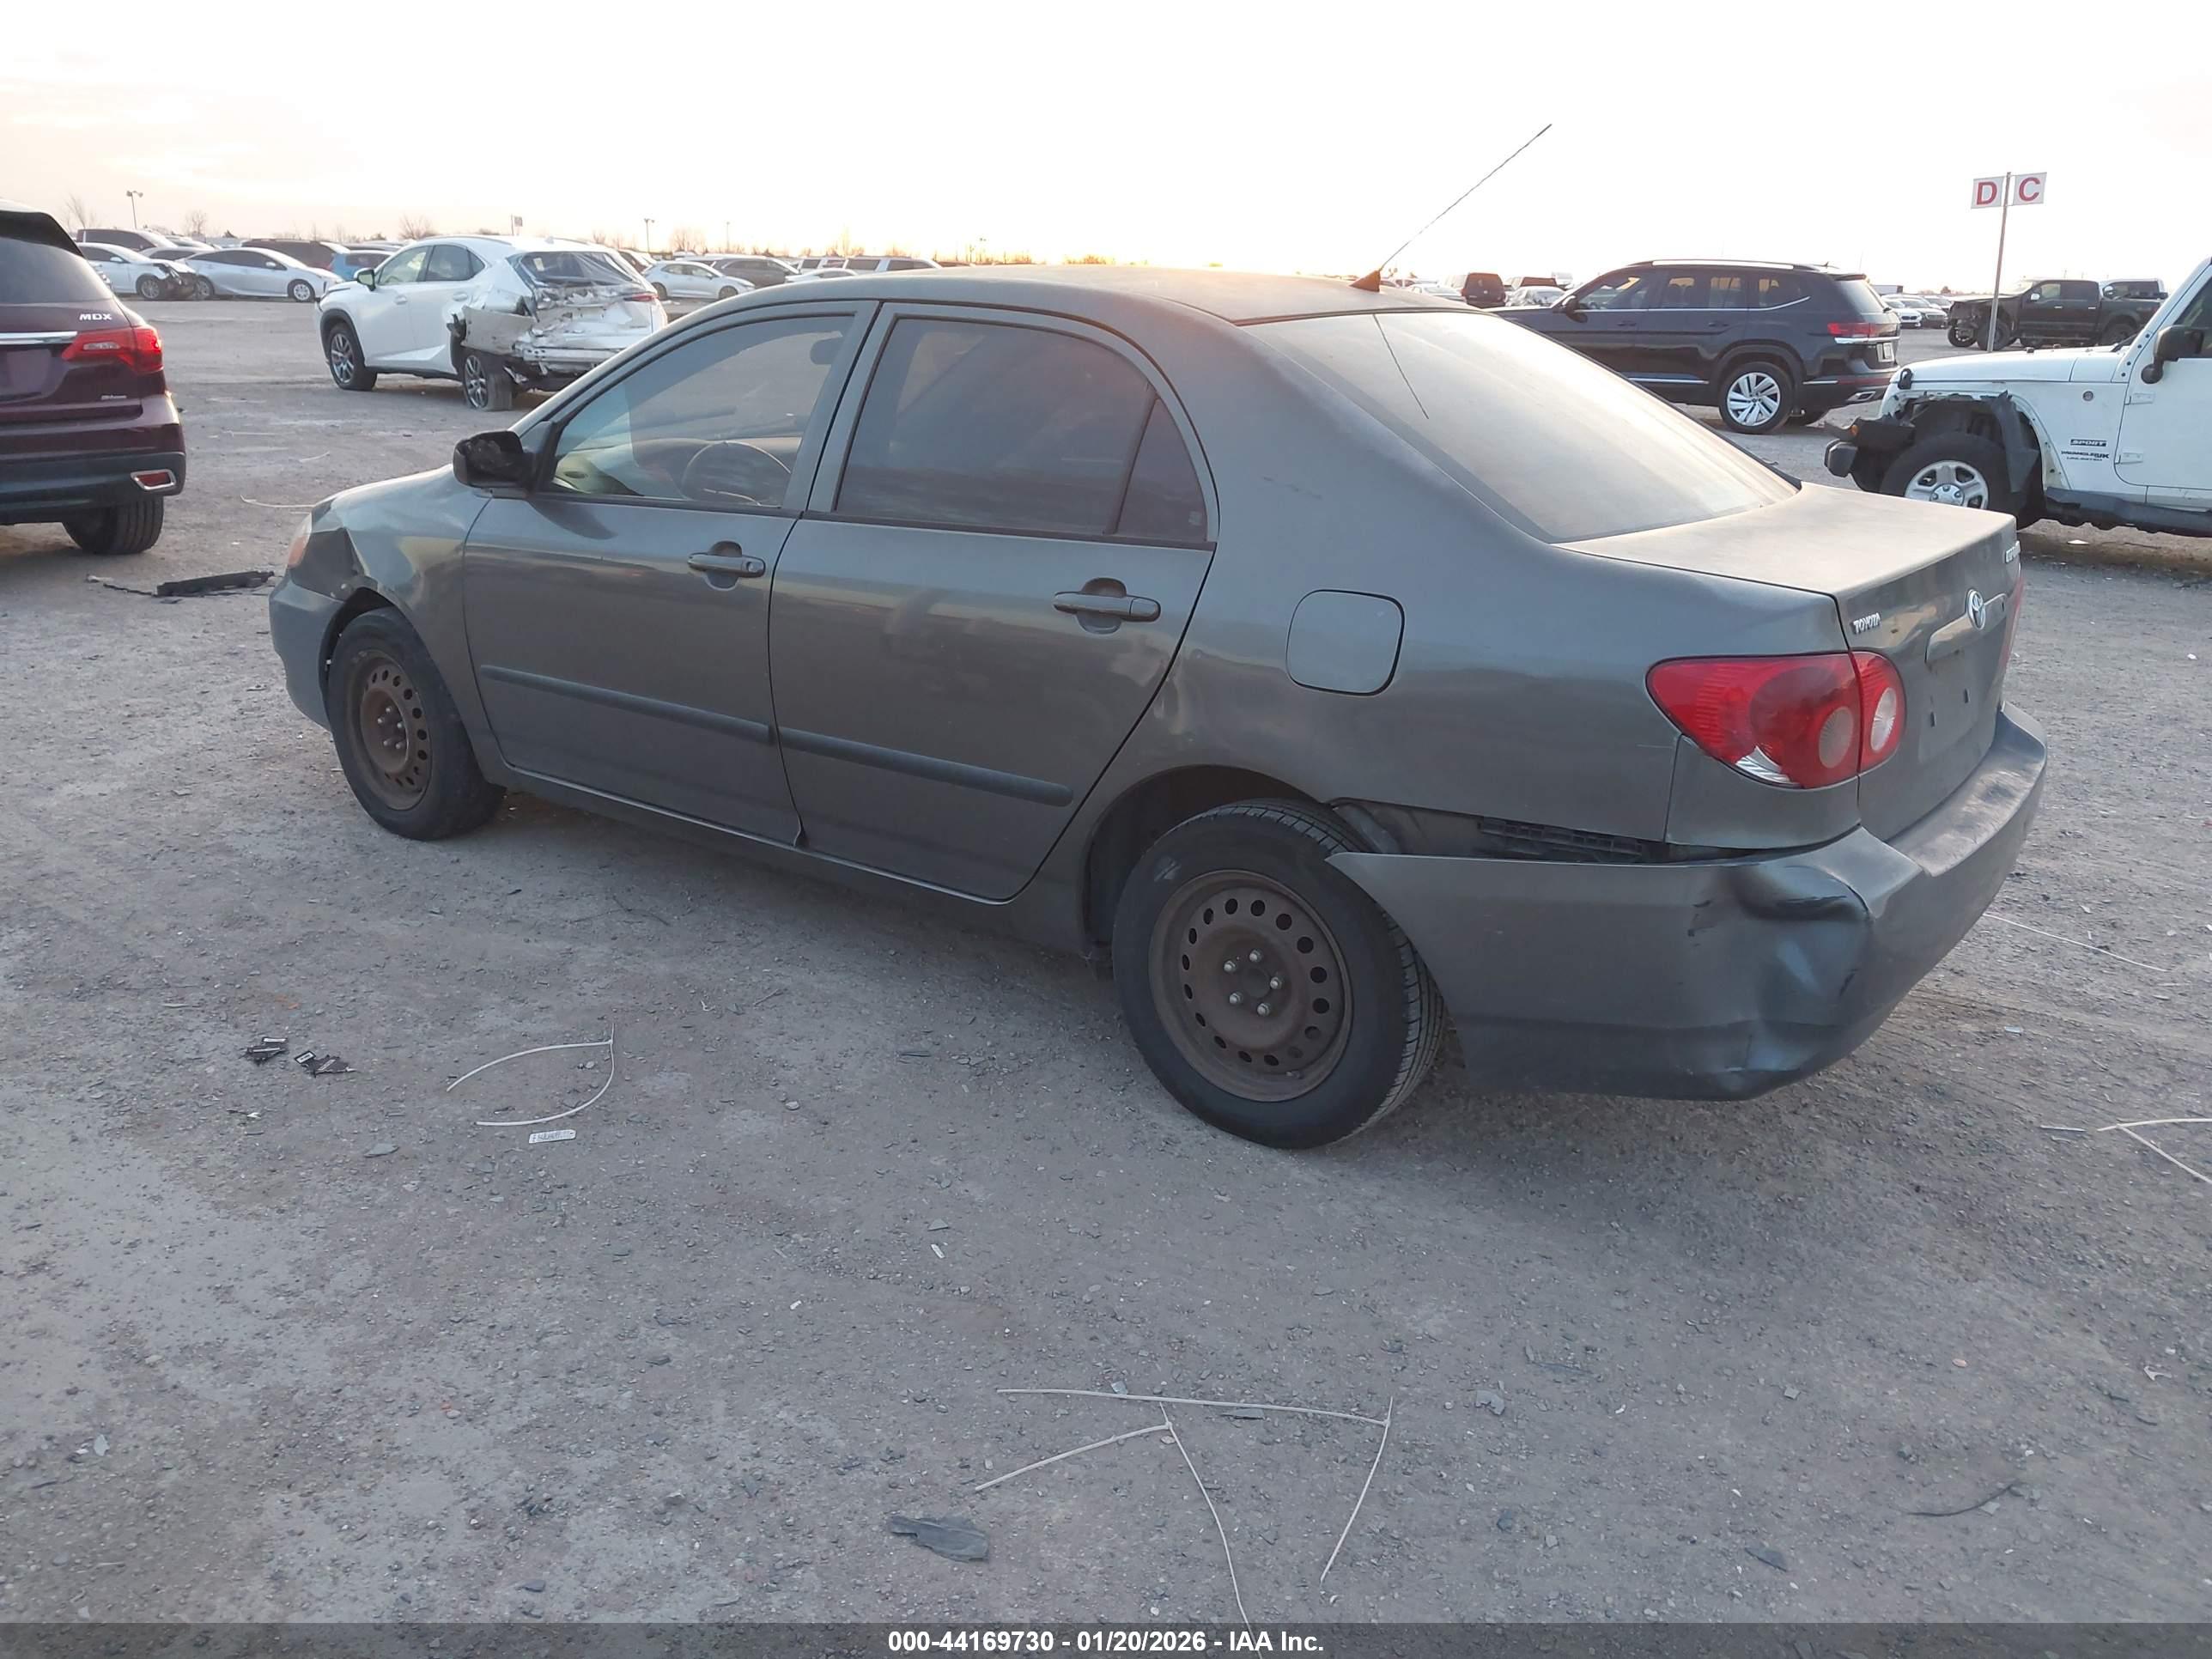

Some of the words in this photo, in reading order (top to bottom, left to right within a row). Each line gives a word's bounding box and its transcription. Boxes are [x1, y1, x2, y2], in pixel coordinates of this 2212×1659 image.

[1977, 181, 1997, 205] D
[2019, 177, 2041, 201] C
[1853, 612, 1881, 634] TOYOTA
